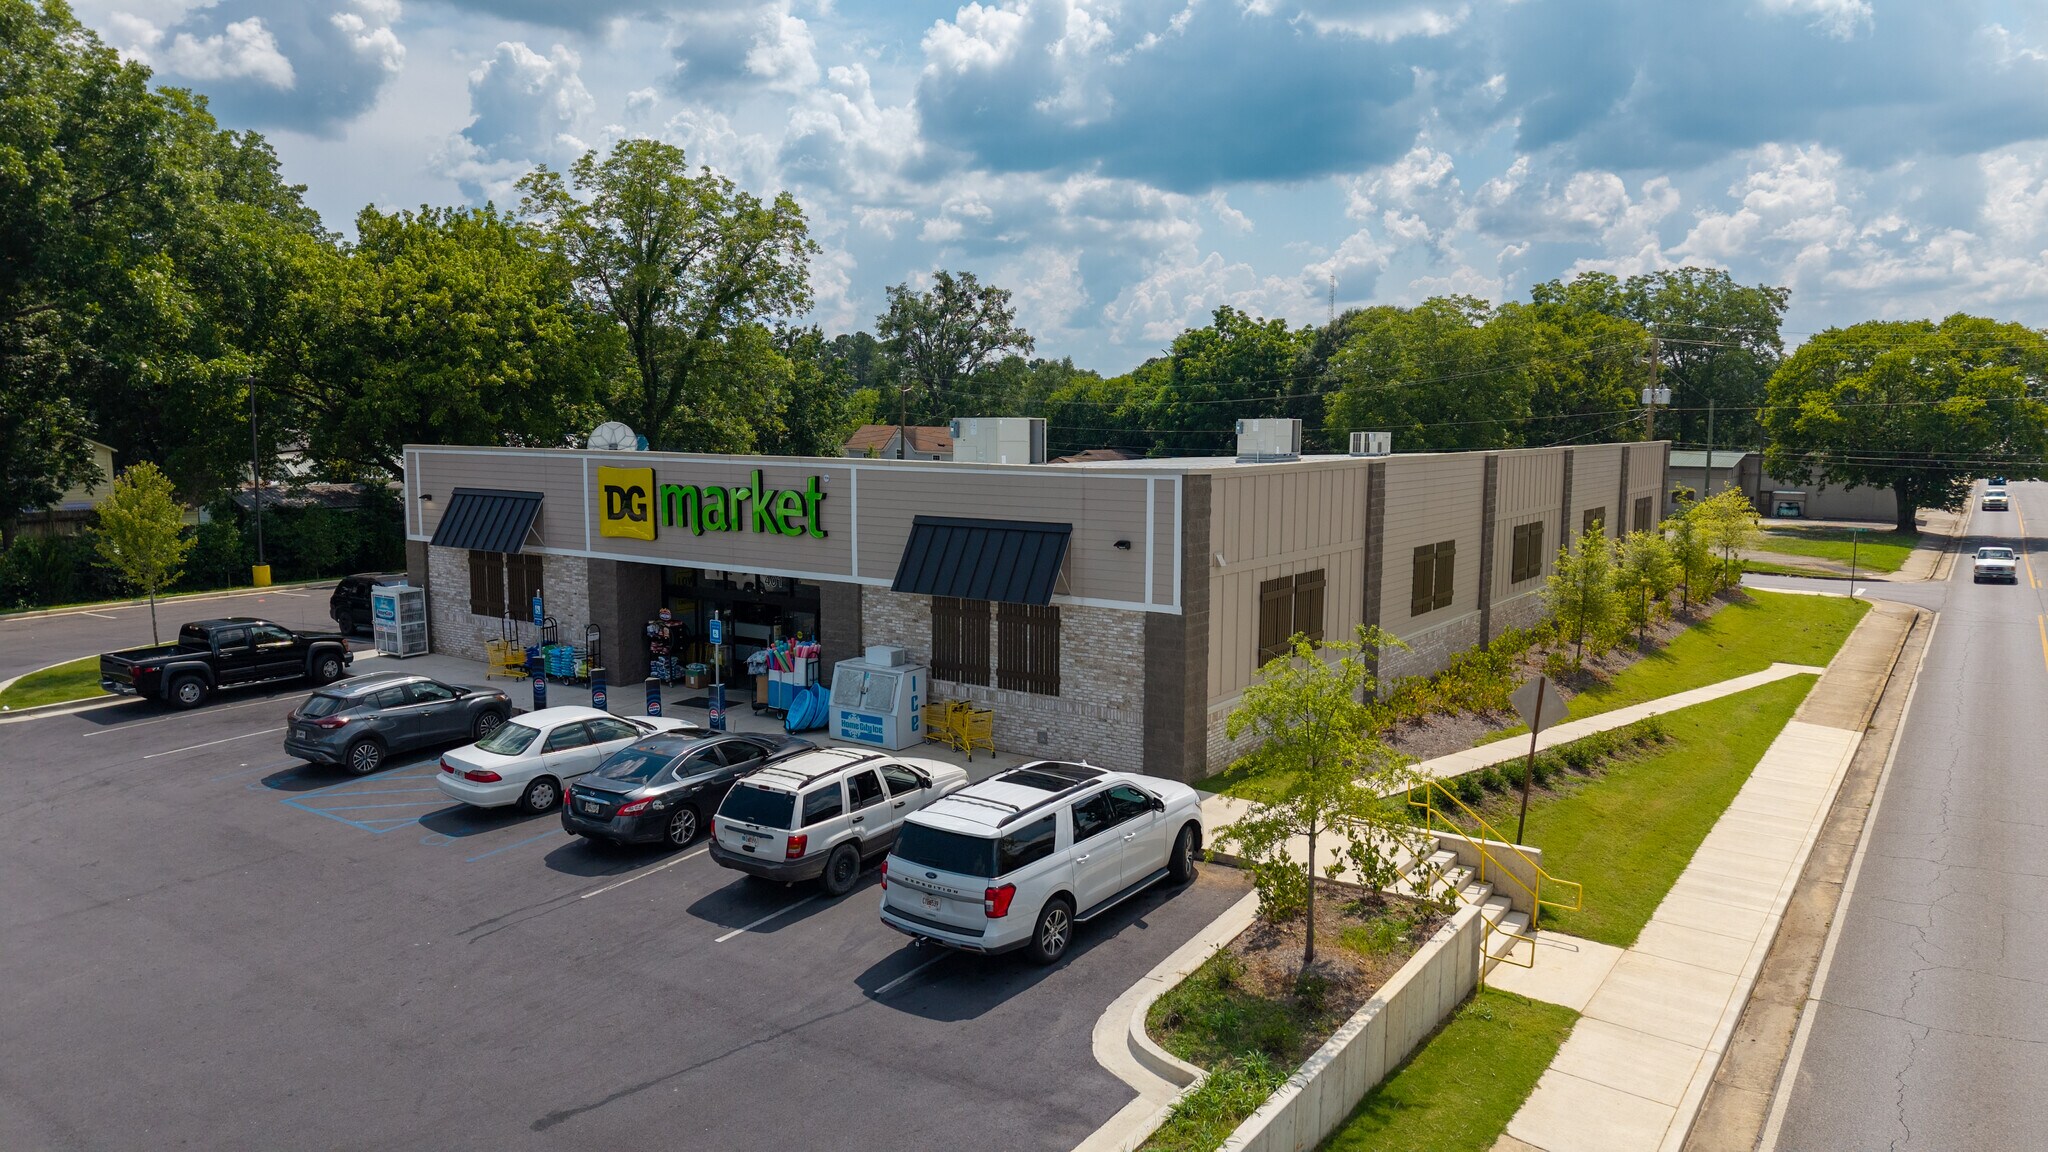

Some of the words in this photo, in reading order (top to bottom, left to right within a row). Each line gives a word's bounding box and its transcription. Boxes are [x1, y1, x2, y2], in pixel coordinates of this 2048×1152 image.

[604, 485, 648, 522] DG
[660, 469, 829, 539] market
[764, 576, 783, 588] 401
[841, 720, 859, 730] Home
[860, 722, 872, 734] City
[872, 725, 883, 734] Ice
[904, 877, 959, 894] EXPEDITION
